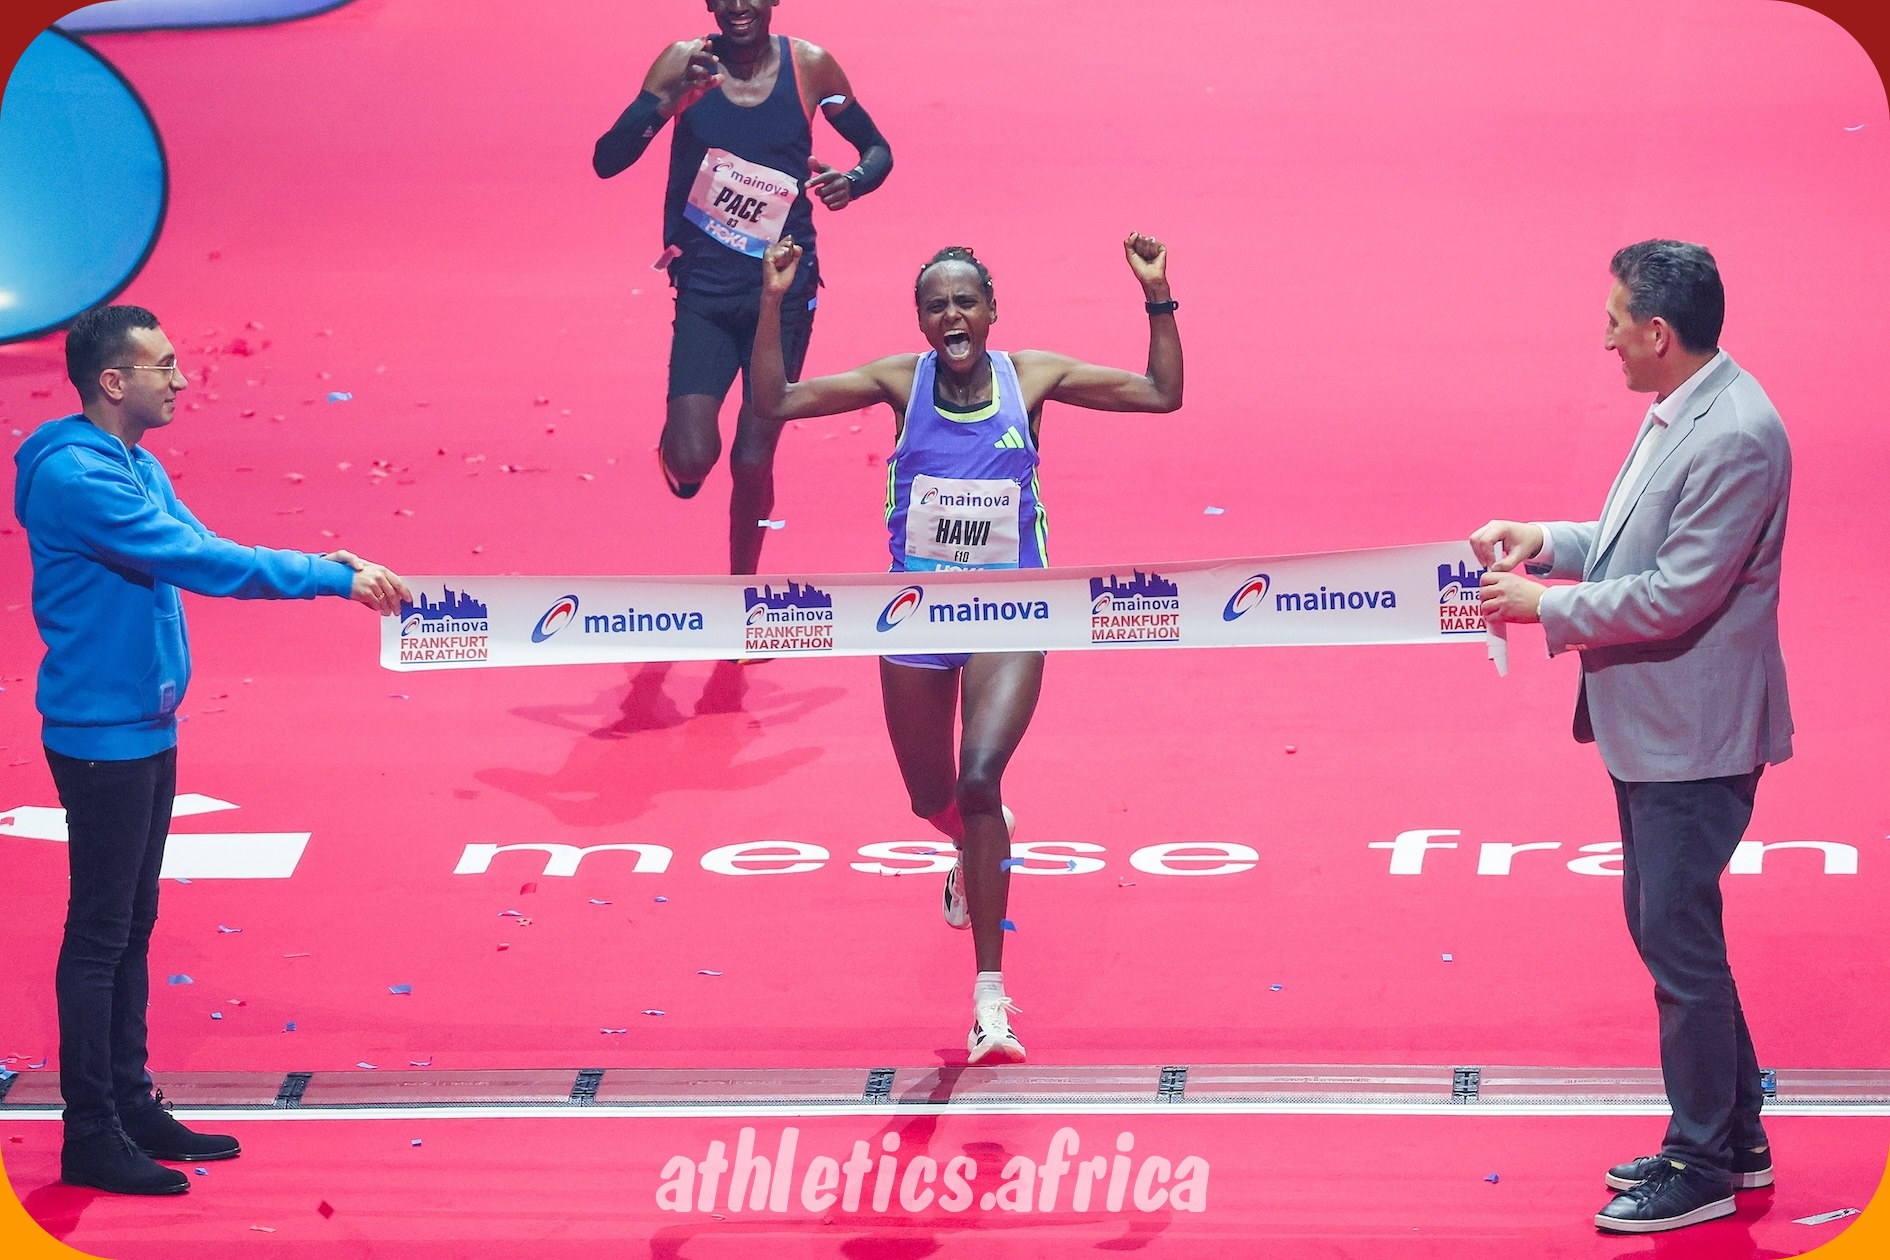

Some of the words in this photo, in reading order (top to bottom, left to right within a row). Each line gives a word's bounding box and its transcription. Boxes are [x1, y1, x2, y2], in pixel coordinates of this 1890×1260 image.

[730, 170, 790, 197] mainova
[713, 186, 768, 223] PACE
[704, 219, 748, 251] HOKA
[939, 492, 1010, 508] mainova
[935, 518, 991, 546] HAWI
[954, 550, 970, 563] F10
[1112, 597, 1180, 612] mainova
[1275, 585, 1397, 612] mainova
[766, 603, 834, 622] mainova
[929, 596, 1049, 623] mainova
[421, 616, 489, 633] mainova
[584, 607, 704, 634] mainova
[1091, 613, 1179, 628] FRANKFURT
[745, 625, 833, 639] FRANKFURT
[1091, 626, 1180, 641] MARATHON
[400, 635, 488, 649] FRANKFURT
[745, 637, 833, 651] MARATHON
[399, 647, 488, 661] MARATHON
[453, 839, 1259, 877] messe
